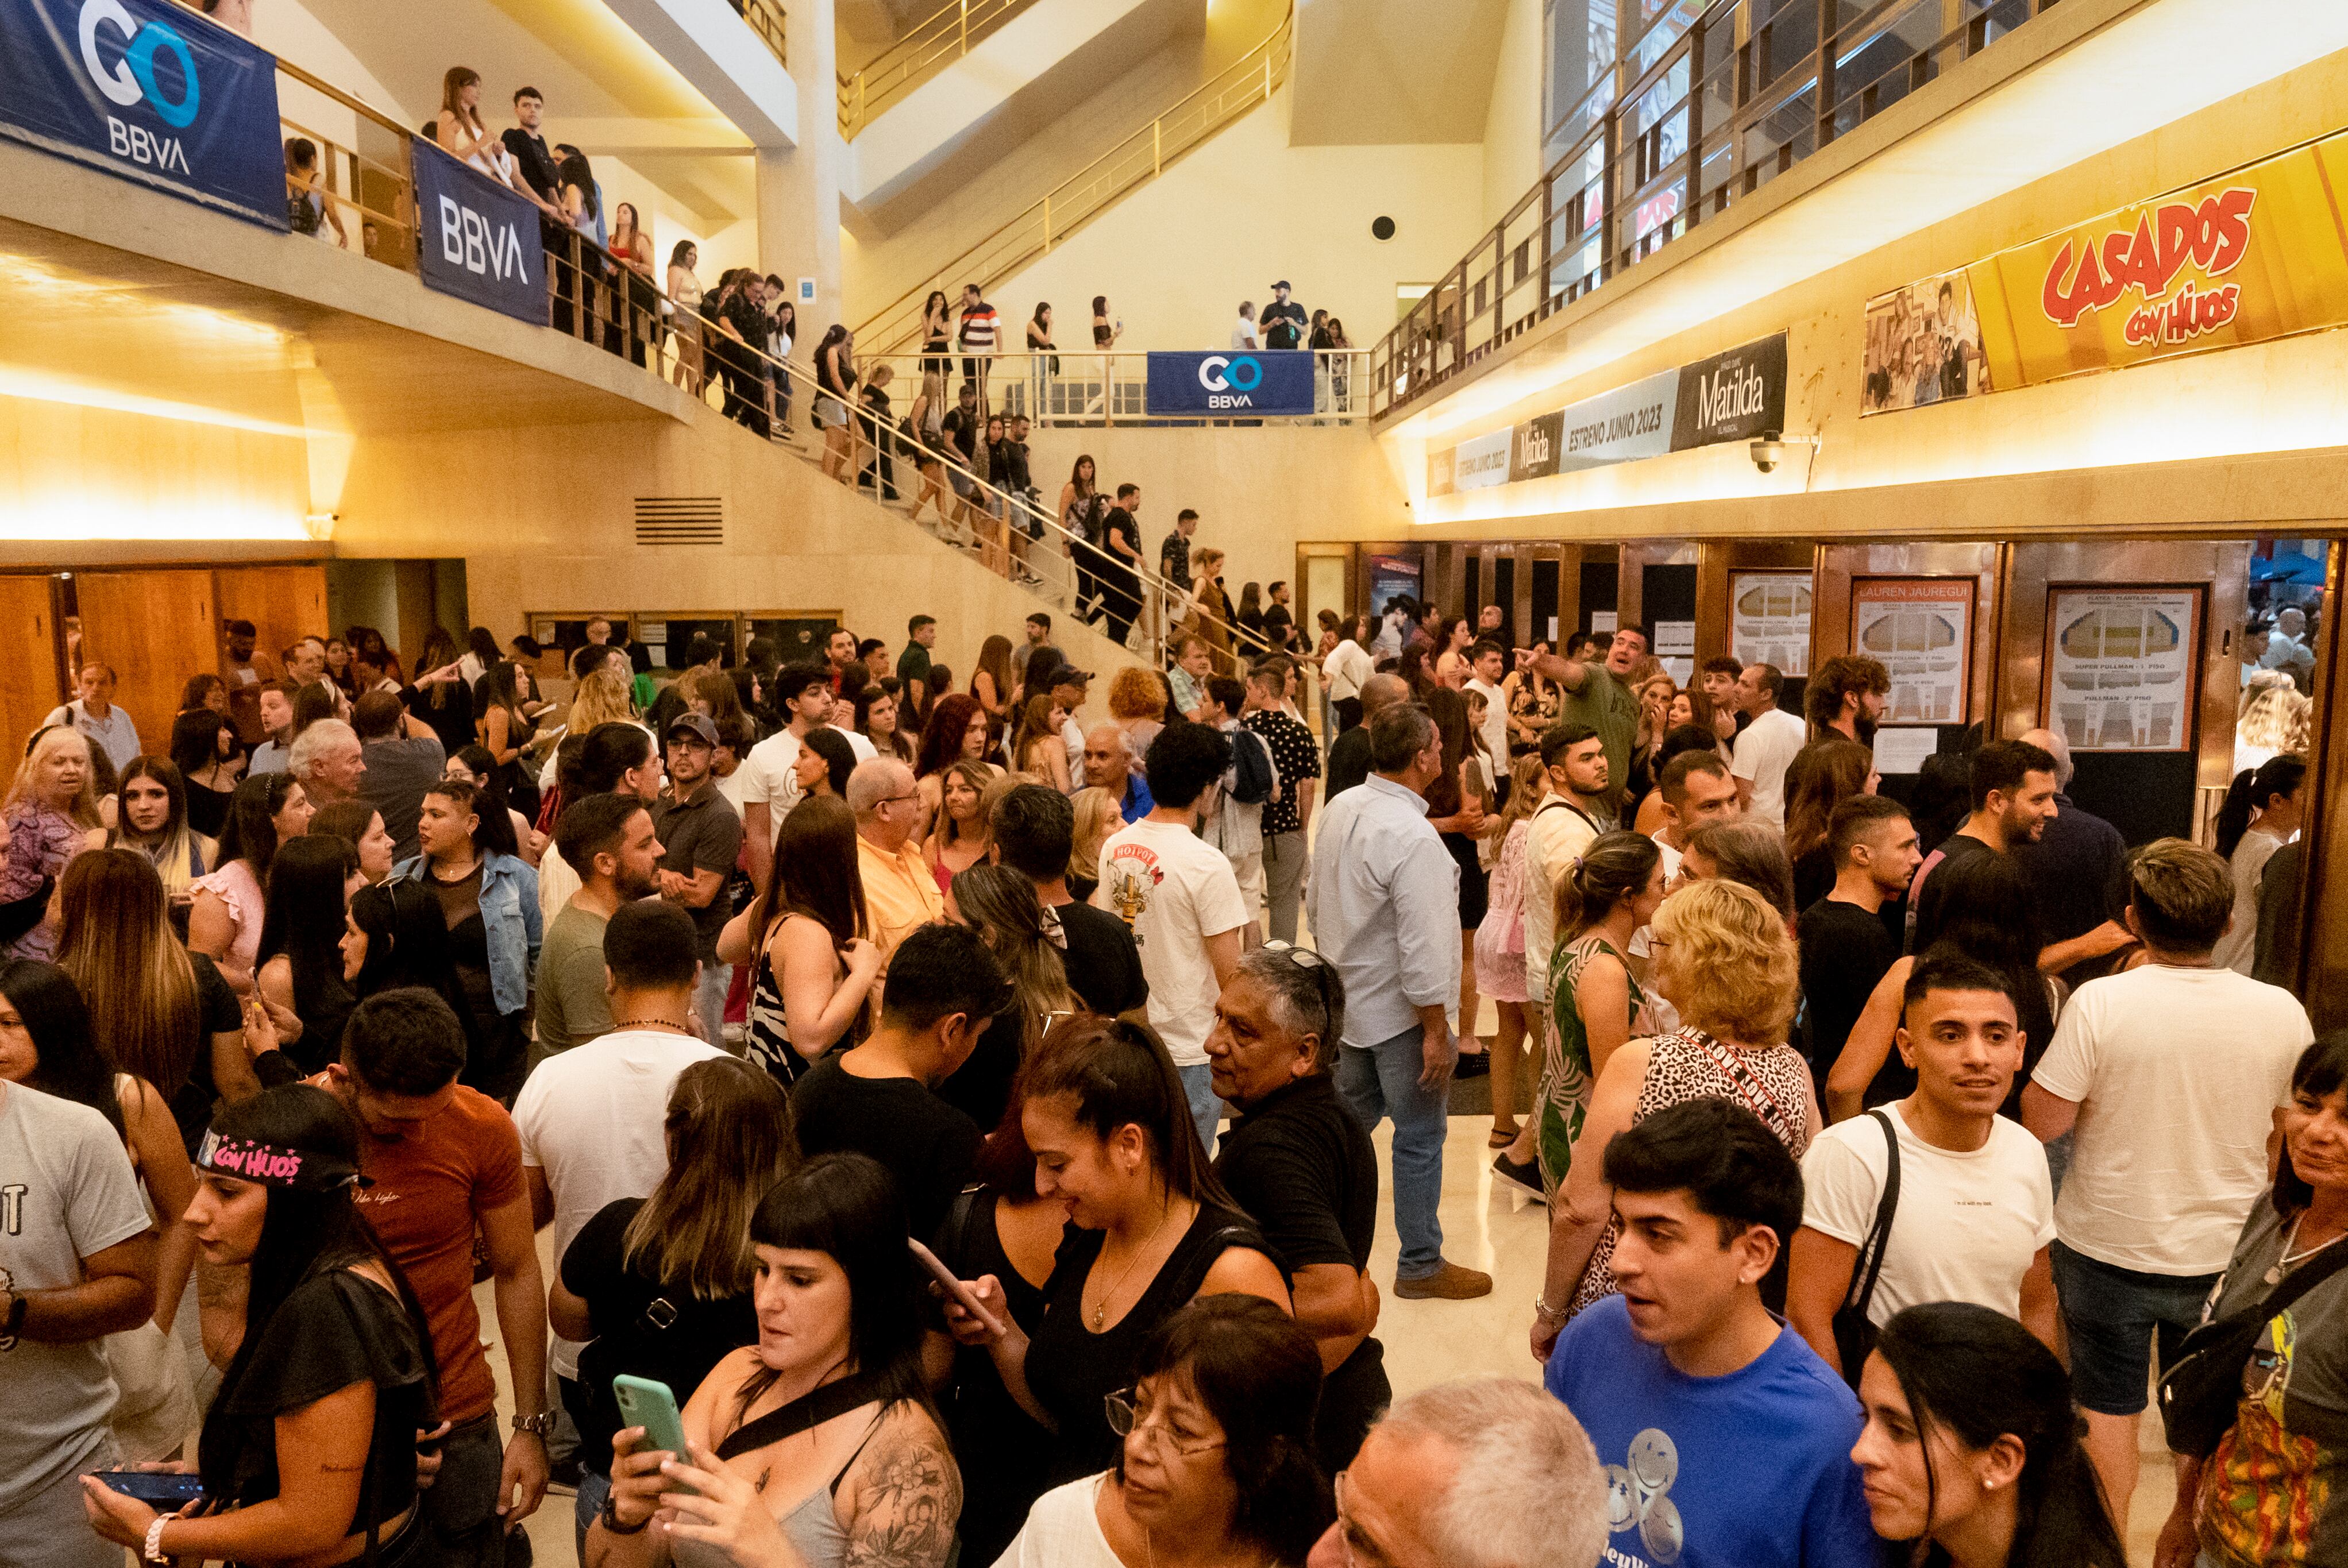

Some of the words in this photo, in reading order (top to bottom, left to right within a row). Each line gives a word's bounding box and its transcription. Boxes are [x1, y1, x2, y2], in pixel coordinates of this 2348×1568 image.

[79, 0, 200, 128] GO
[107, 115, 190, 175] BBVA
[439, 193, 529, 285] BBVA
[2042, 188, 2257, 327] CASADOS
[2124, 305, 2166, 347] CON
[1198, 356, 1263, 392] GO
[1209, 395, 1253, 408] BBVA
[1697, 363, 1764, 430] Matilda
[1569, 421, 1605, 452] ESTRENO
[1606, 412, 1634, 443] JUNIO
[1636, 403, 1663, 436] 2023
[1520, 429, 1549, 469] Matilda
[1860, 587, 1906, 597] LAUREN
[1909, 587, 1968, 597] JAUREGUI
[1117, 846, 1154, 863] HOTPOT
[1705, 1038, 1743, 1077] LOVE
[1740, 1074, 1773, 1114] LOVE
[214, 1146, 247, 1172] CON
[0, 1184, 28, 1236] T
[374, 1191, 402, 1206] higher
